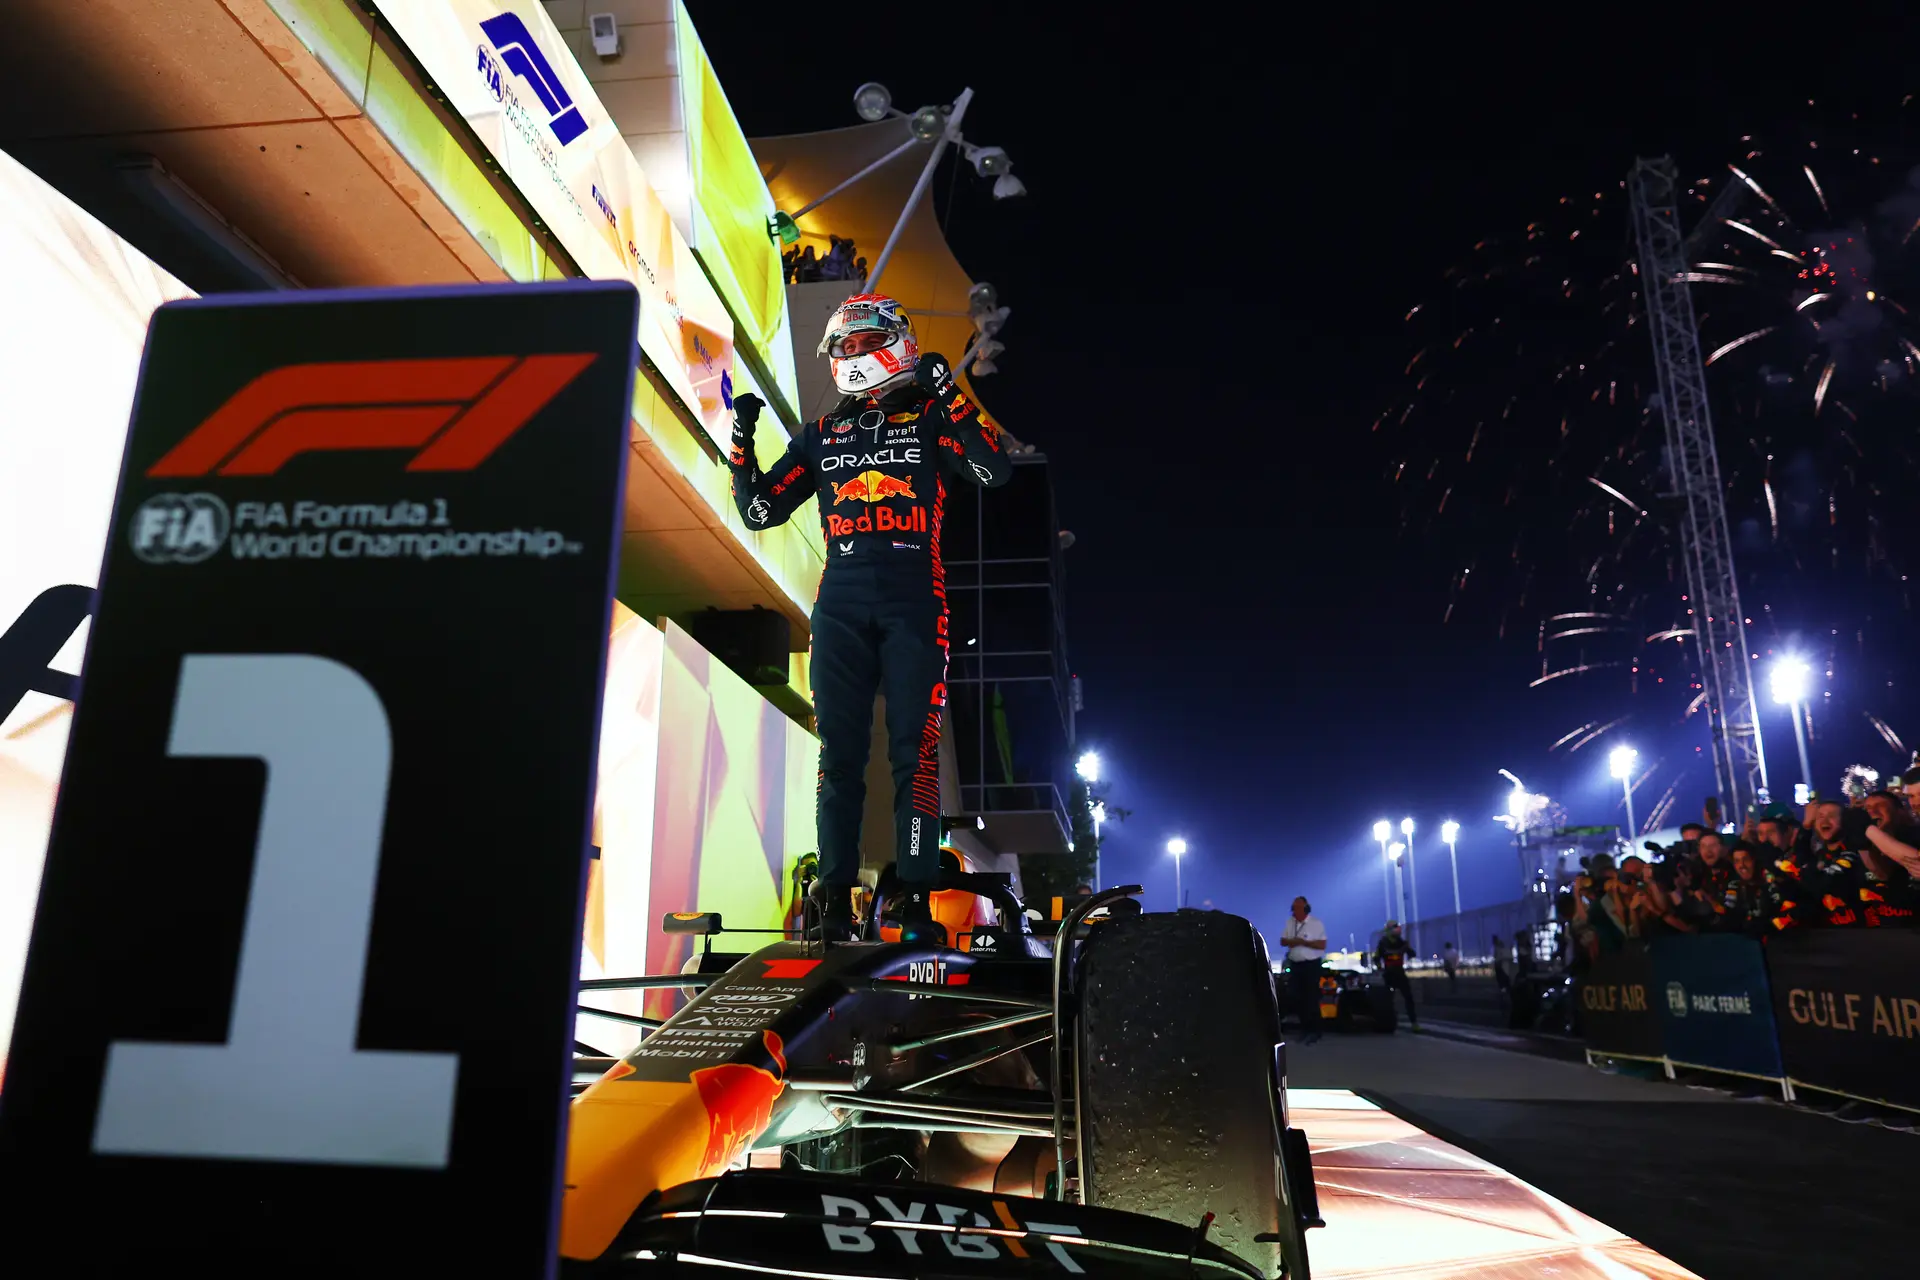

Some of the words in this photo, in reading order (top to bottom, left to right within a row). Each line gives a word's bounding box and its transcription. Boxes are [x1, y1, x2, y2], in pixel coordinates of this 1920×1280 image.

[505, 84, 519, 109] FIA
[628, 240, 655, 285] aramco
[849, 370, 867, 382] EA
[822, 436, 848, 446] Mobil
[884, 437, 920, 445] HONDA
[887, 425, 918, 437] BYBIT
[821, 448, 922, 472] ORACLE
[783, 465, 805, 484] WINGS
[235, 501, 287, 528] FIA
[297, 500, 430, 529] Formula
[432, 498, 450, 526] 1
[826, 506, 873, 538] Red
[875, 505, 927, 533] Bull
[230, 531, 327, 561] World
[910, 817, 921, 857] sparco
[91, 653, 461, 1171] 1
[1583, 985, 1619, 1011] GULF
[1621, 985, 1648, 1011] AIR
[1692, 993, 1717, 1012] PARC
[1718, 991, 1752, 1014] FERMÉ
[693, 1006, 781, 1015] zoom
[1788, 988, 1862, 1031] GULF
[1873, 995, 1920, 1039] AIR
[661, 1028, 757, 1038] PIRELLI
[634, 1048, 707, 1059] Mobil
[821, 1194, 1086, 1274] BYBIT
